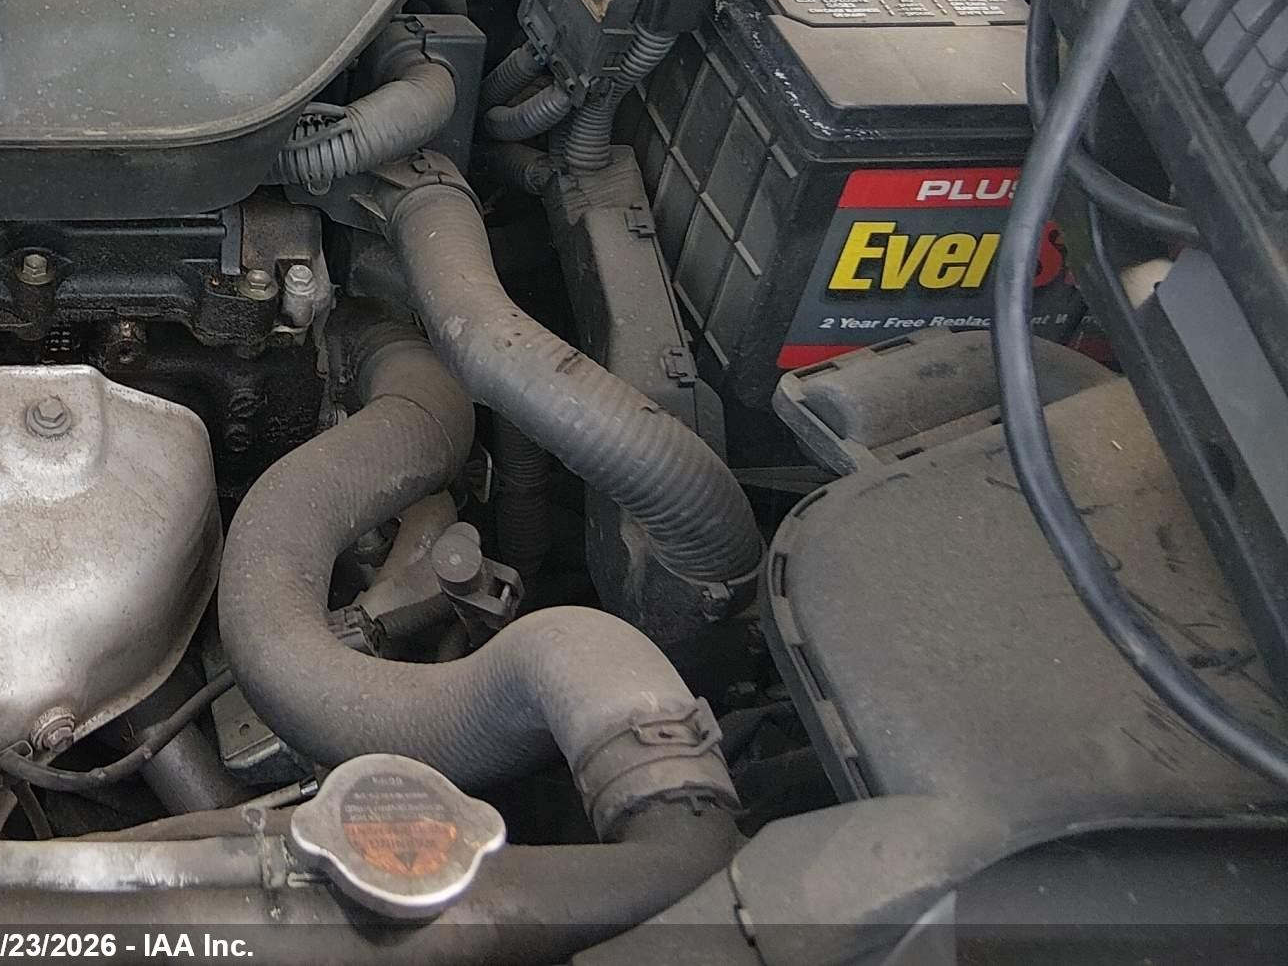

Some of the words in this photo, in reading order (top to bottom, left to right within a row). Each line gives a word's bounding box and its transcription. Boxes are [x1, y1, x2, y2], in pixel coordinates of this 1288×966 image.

[818, 317, 835, 329] 2
[839, 317, 880, 329] Year
[883, 316, 924, 328] Free
